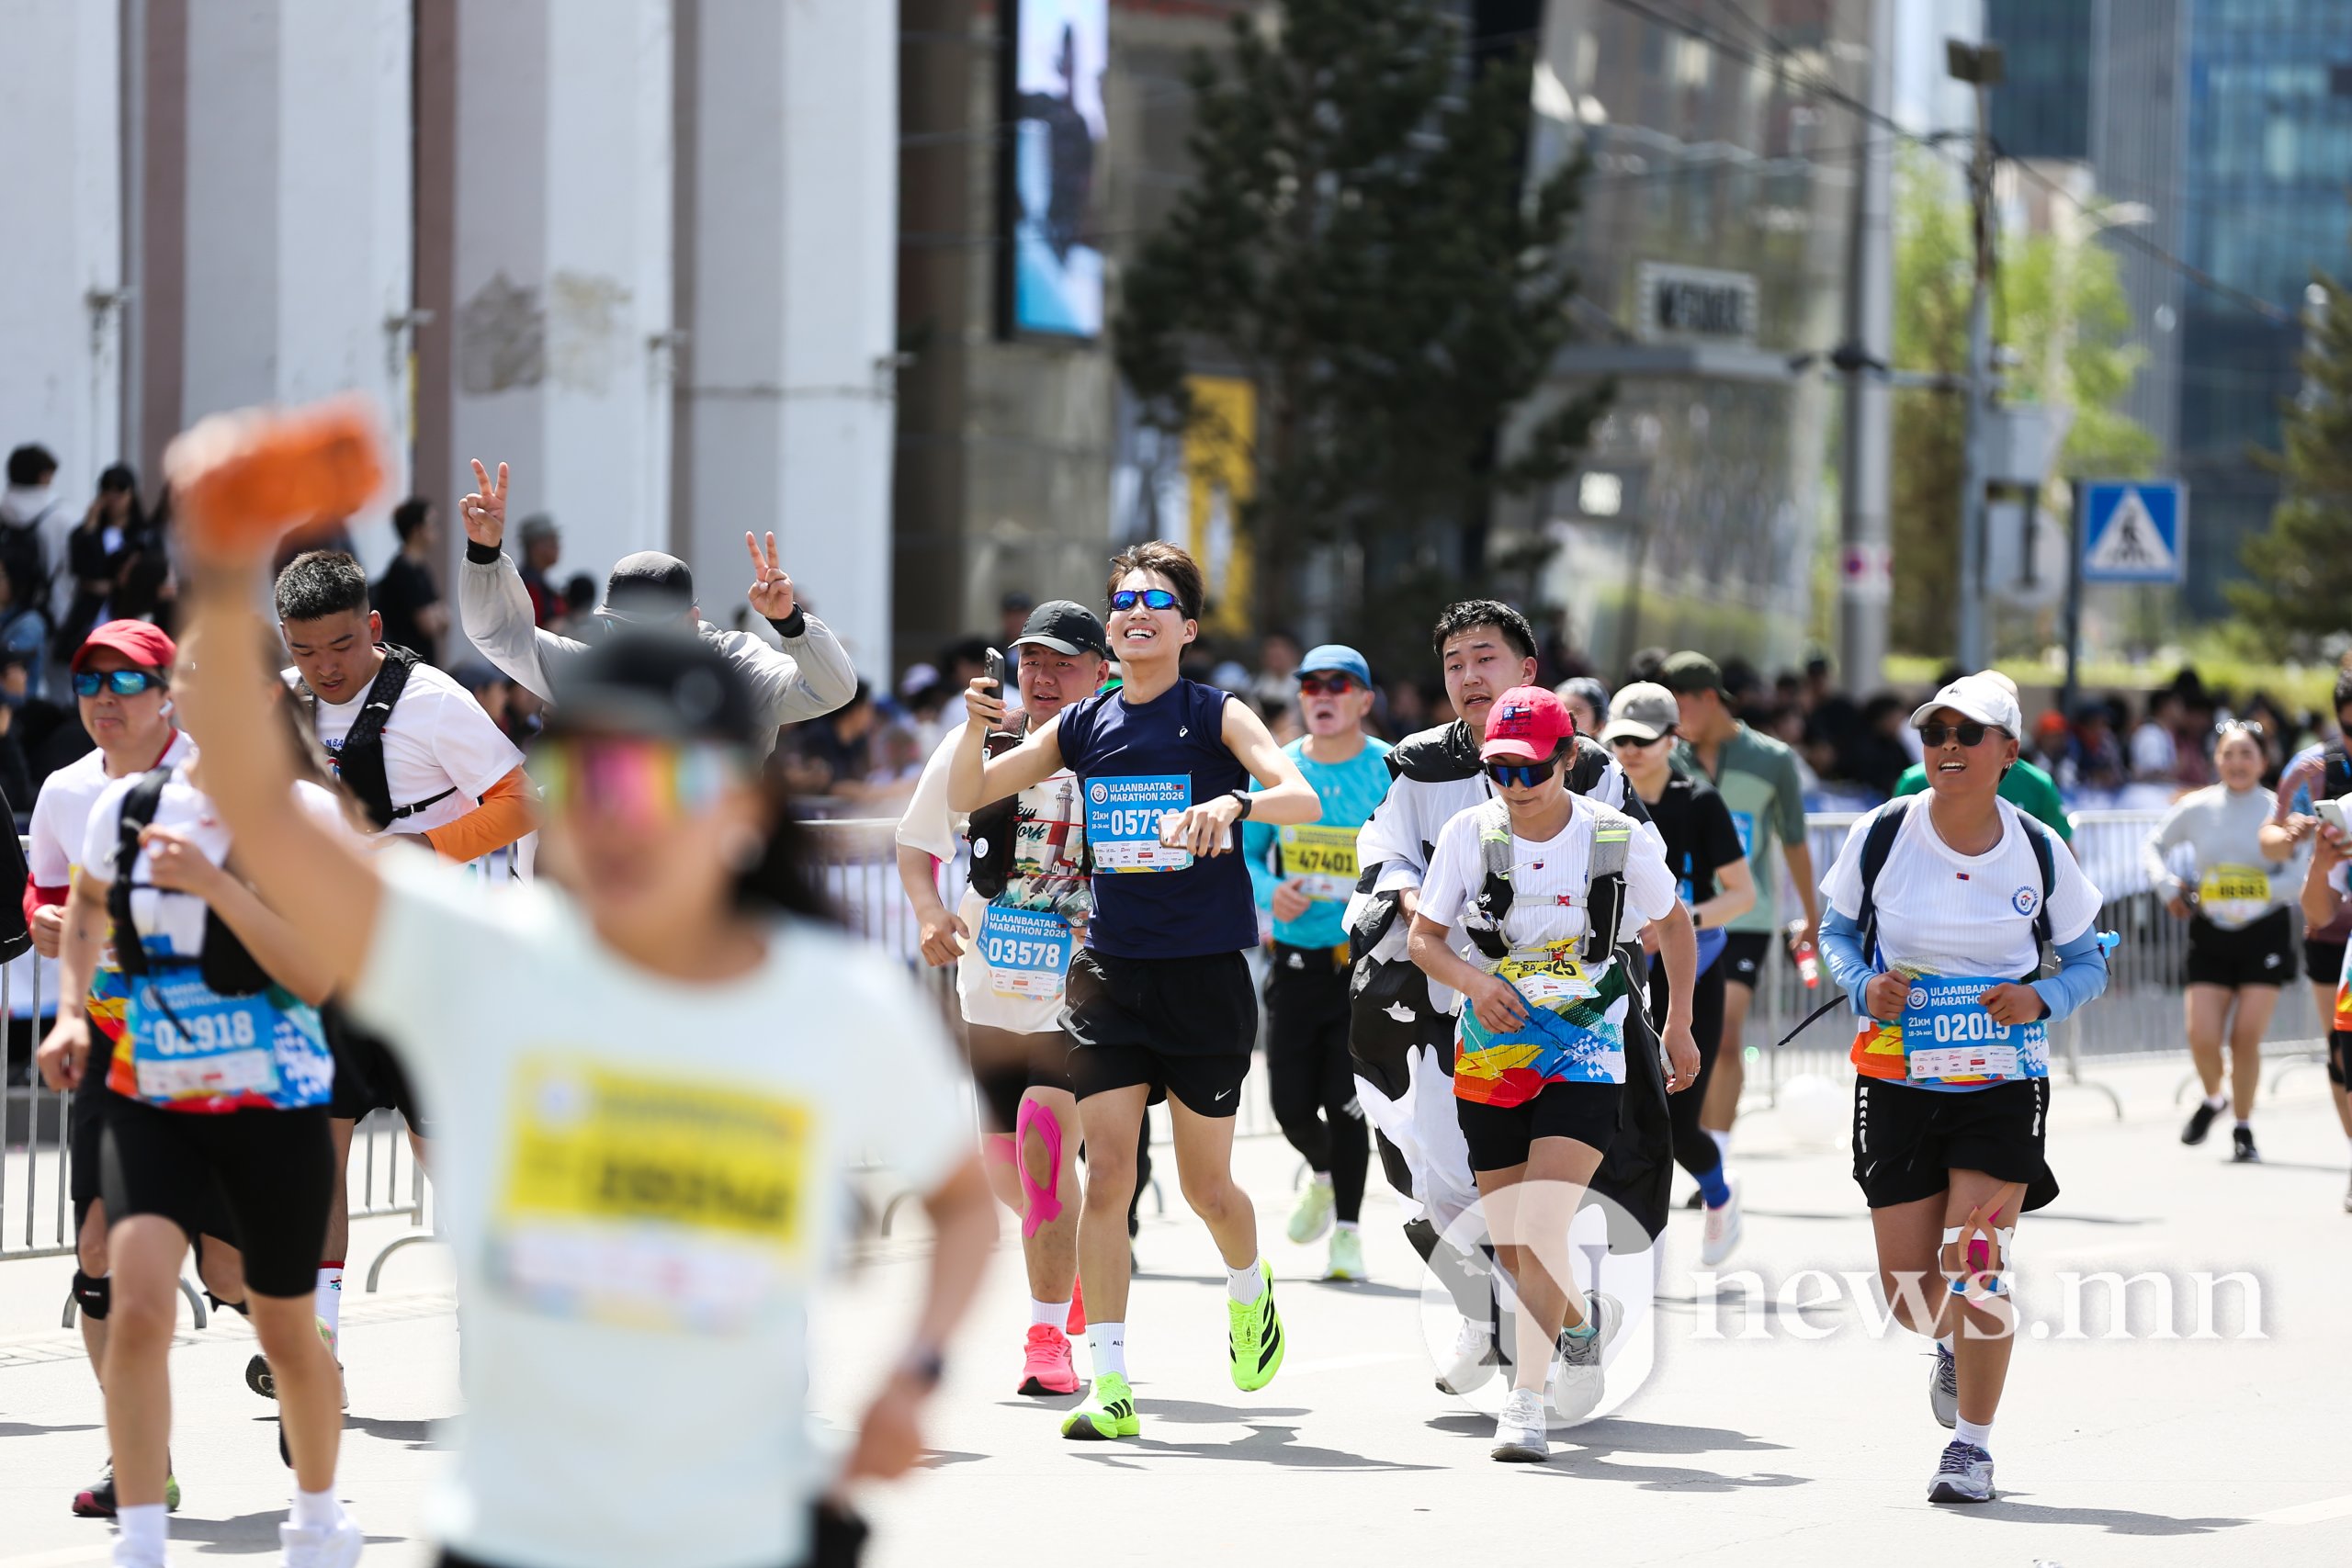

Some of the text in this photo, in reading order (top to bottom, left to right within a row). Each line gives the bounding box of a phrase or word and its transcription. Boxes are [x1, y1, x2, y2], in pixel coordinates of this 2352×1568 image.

[1109, 783, 1172, 793] ULAANBAATAR
[1110, 792, 1184, 802] MARATHON 2026
[1111, 808, 1180, 836] 0573
[1017, 822, 1046, 840] ork
[1299, 850, 1353, 873] 47401
[989, 913, 1057, 929] ULAANBAATAR
[989, 922, 1067, 938] MARATHON 2026
[988, 937, 1060, 968] 03578
[1929, 985, 1995, 997] ULAANBAAT
[1930, 995, 1981, 1007] MARATHO
